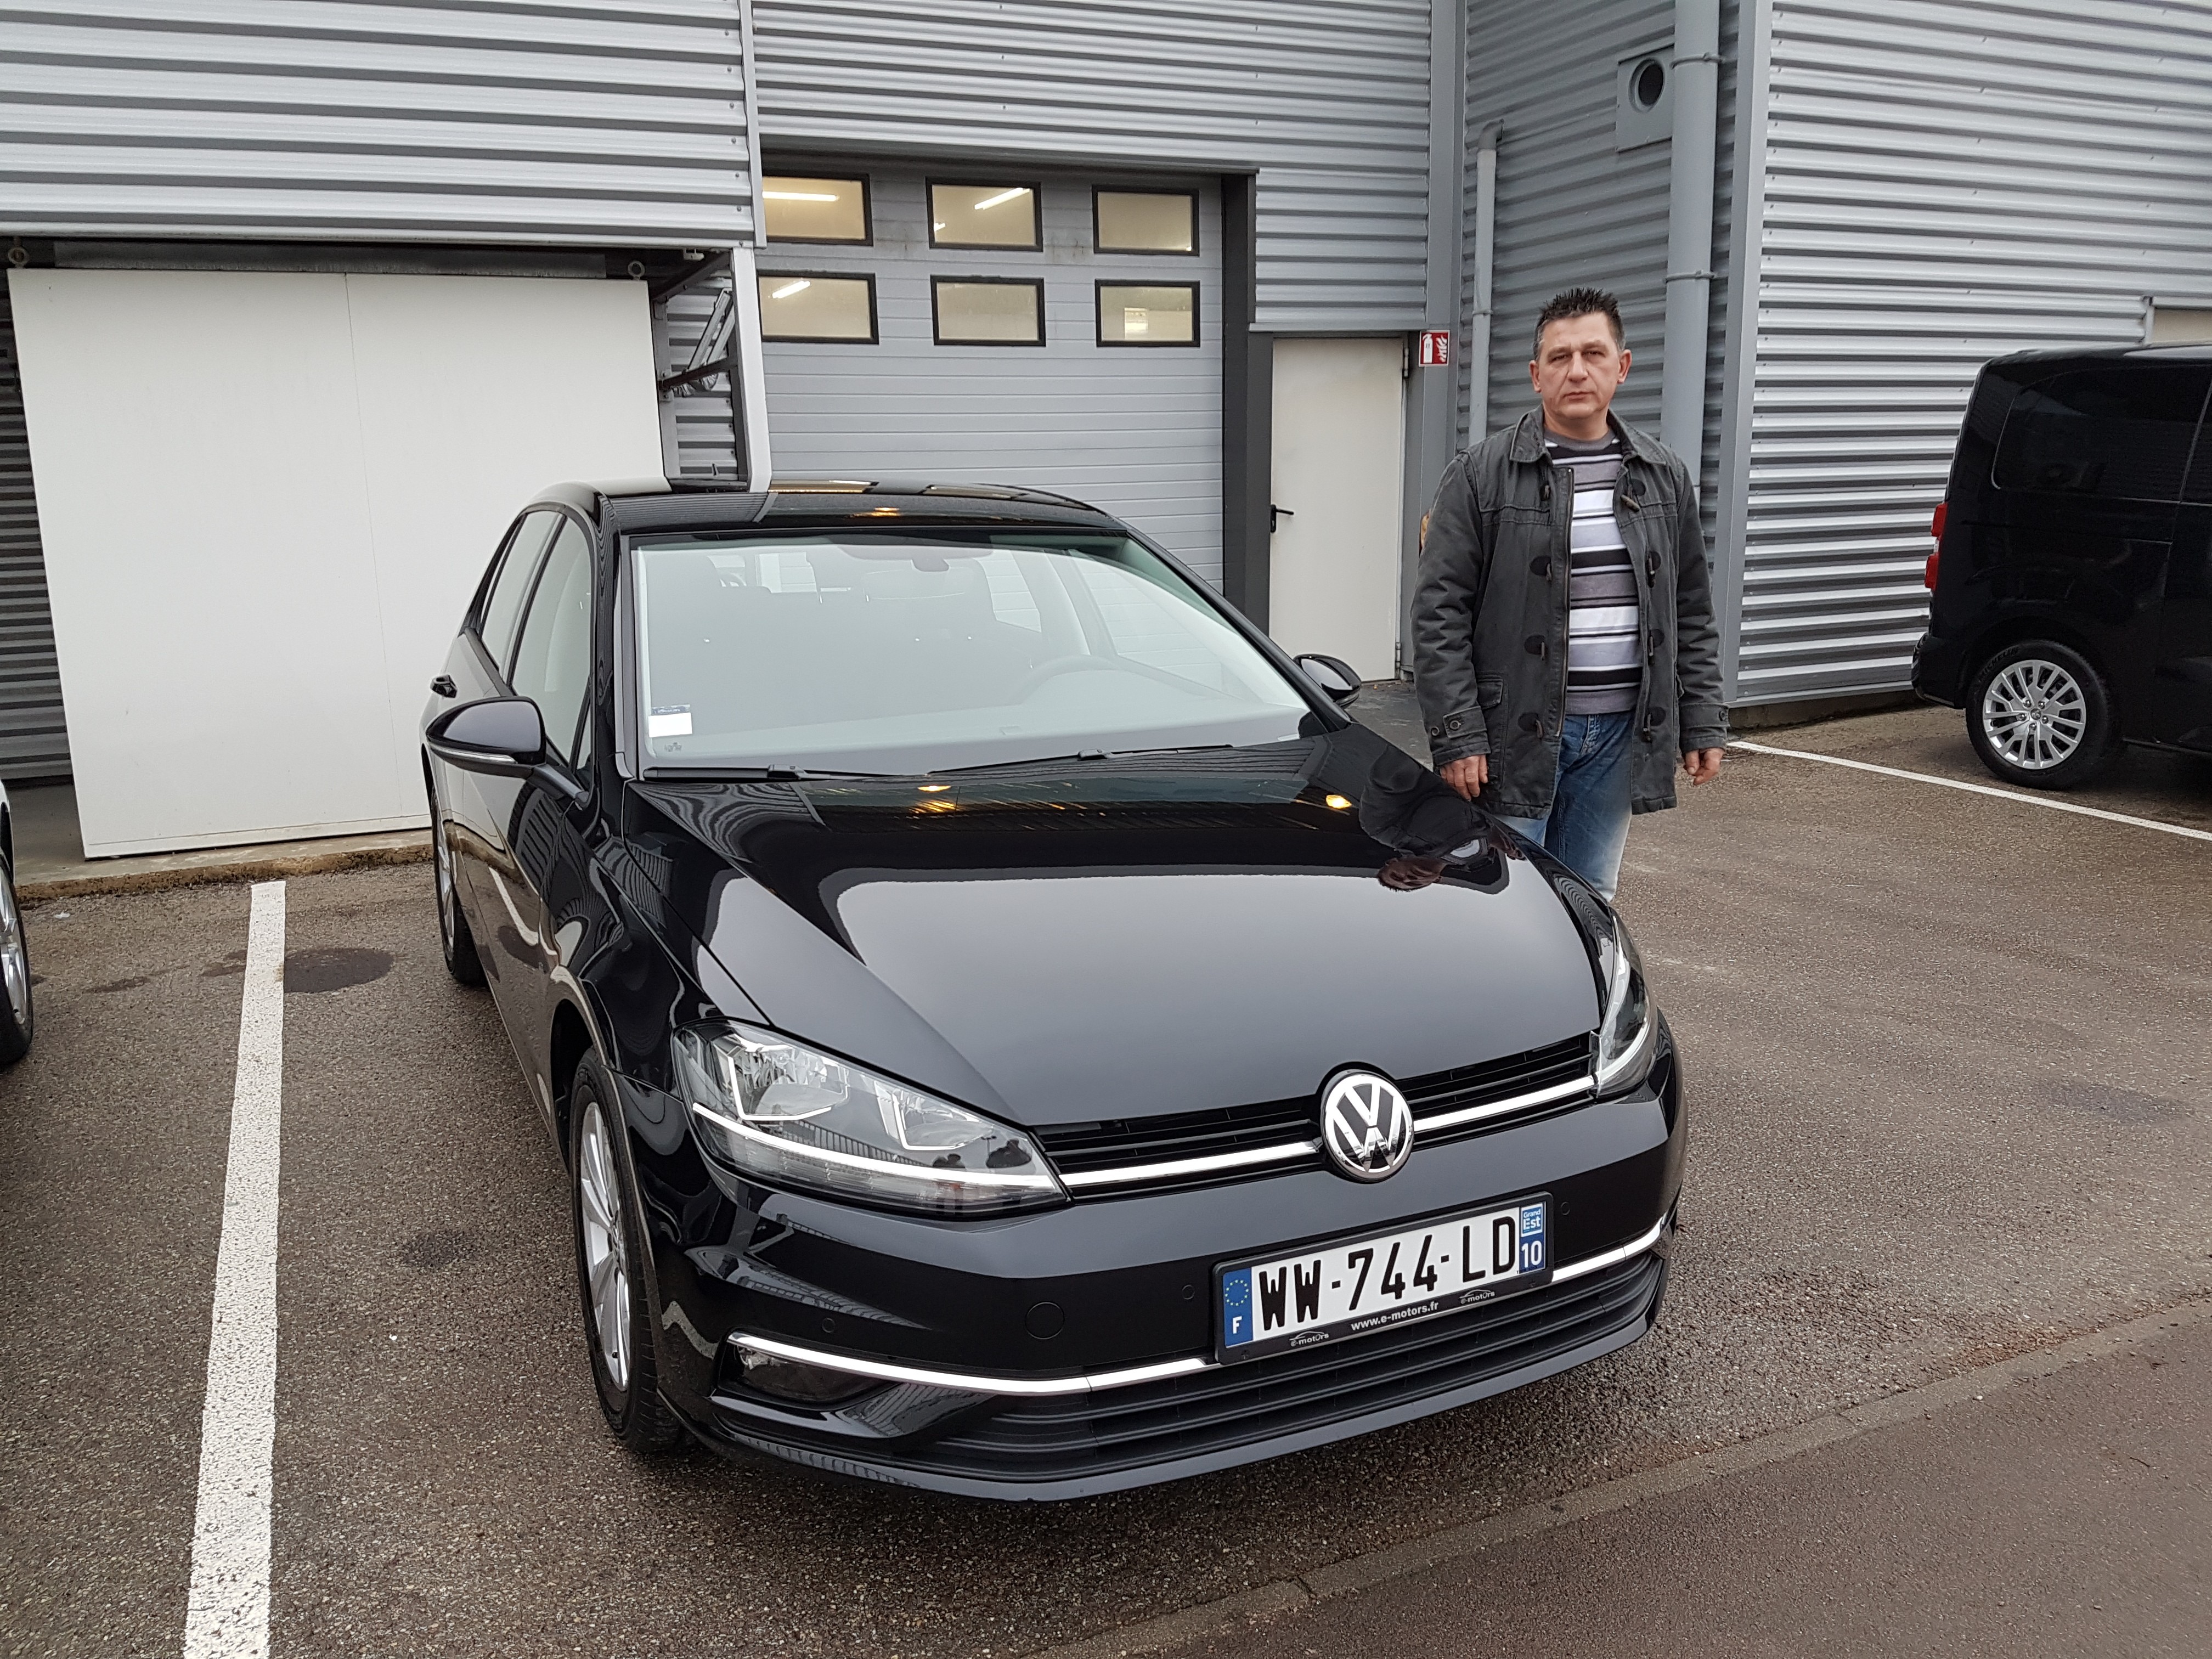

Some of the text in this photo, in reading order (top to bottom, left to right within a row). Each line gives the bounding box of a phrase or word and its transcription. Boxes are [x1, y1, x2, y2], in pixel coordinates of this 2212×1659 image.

[1523, 1209, 1541, 1218] Grand
[1523, 1216, 1541, 1231] Est
[1522, 1240, 1542, 1268] 10
[1259, 1216, 1516, 1331] WW-744-LD
[1232, 1316, 1243, 1334] F
[1351, 1301, 1439, 1331] www.e-motors.fr
